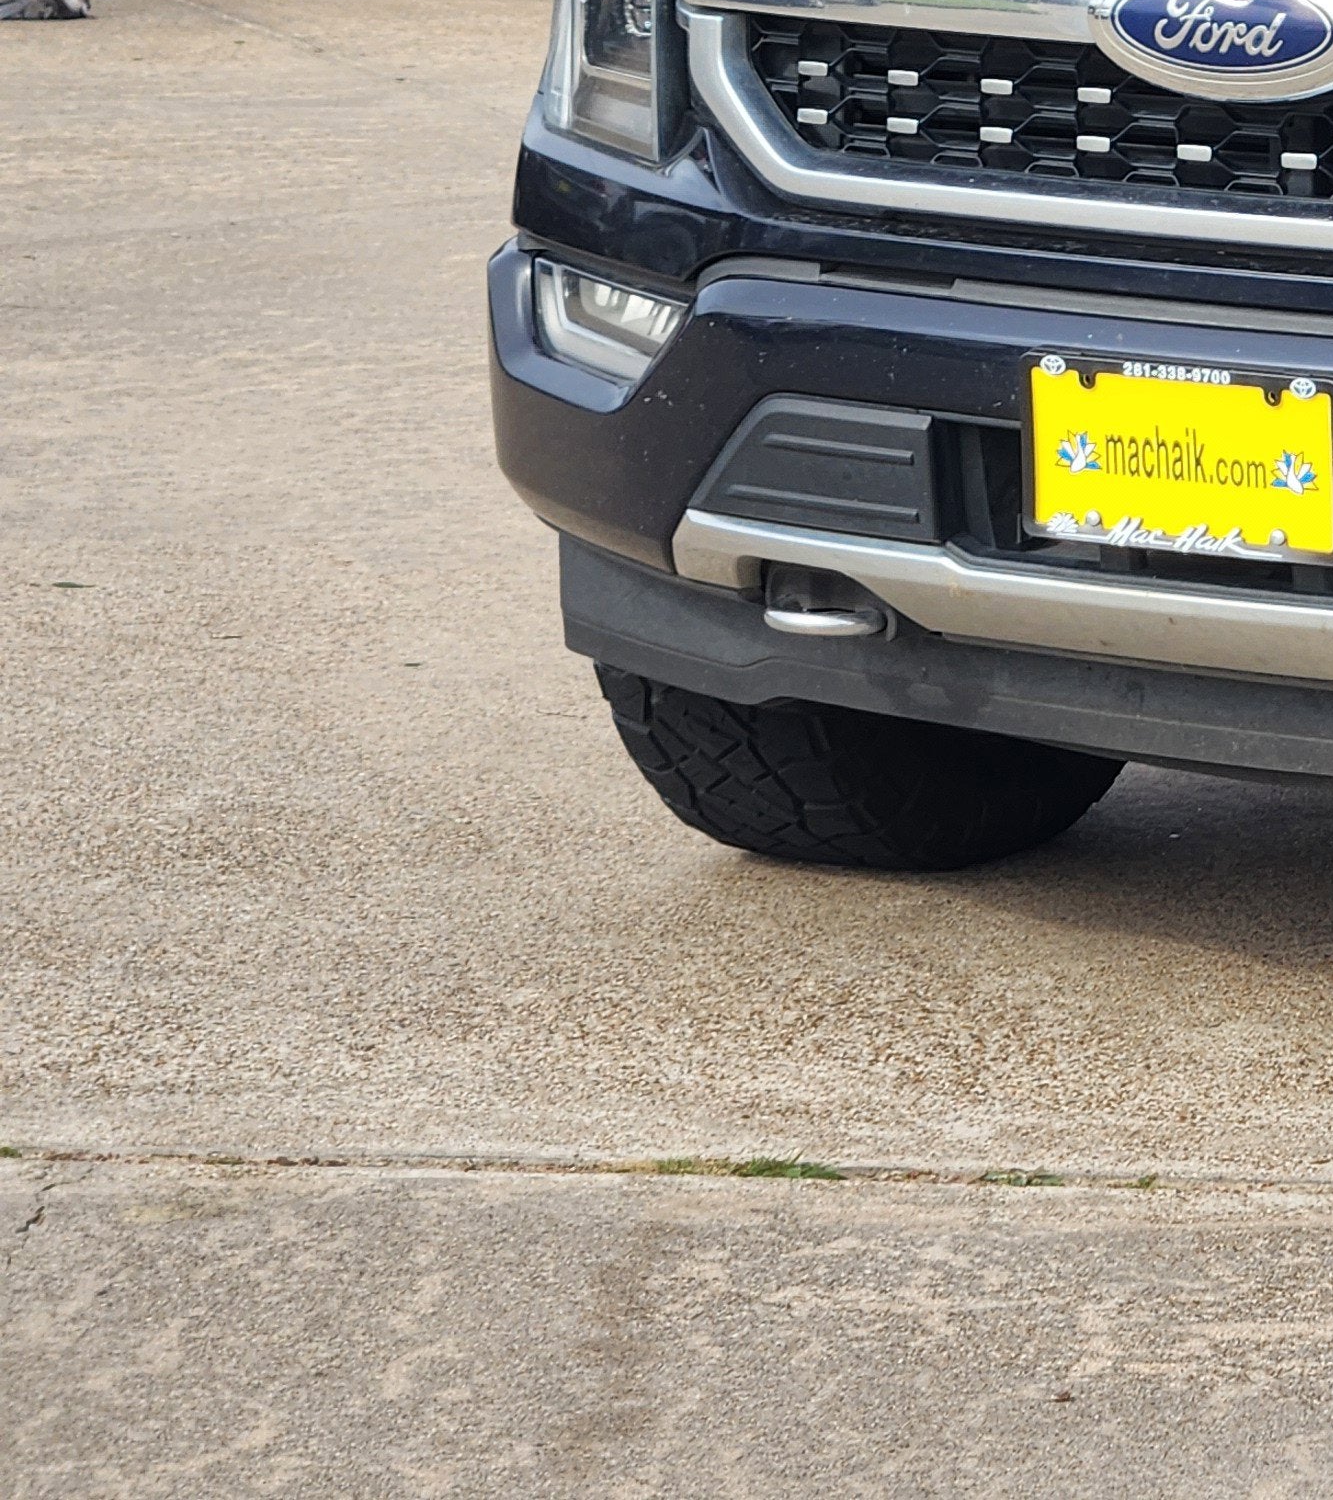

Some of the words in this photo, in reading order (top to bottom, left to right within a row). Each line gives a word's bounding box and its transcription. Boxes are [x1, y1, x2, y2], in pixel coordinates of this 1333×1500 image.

[1103, 424, 1268, 489] machaik.com
[1102, 515, 1174, 546] Mac
[1174, 523, 1260, 554] Haik
